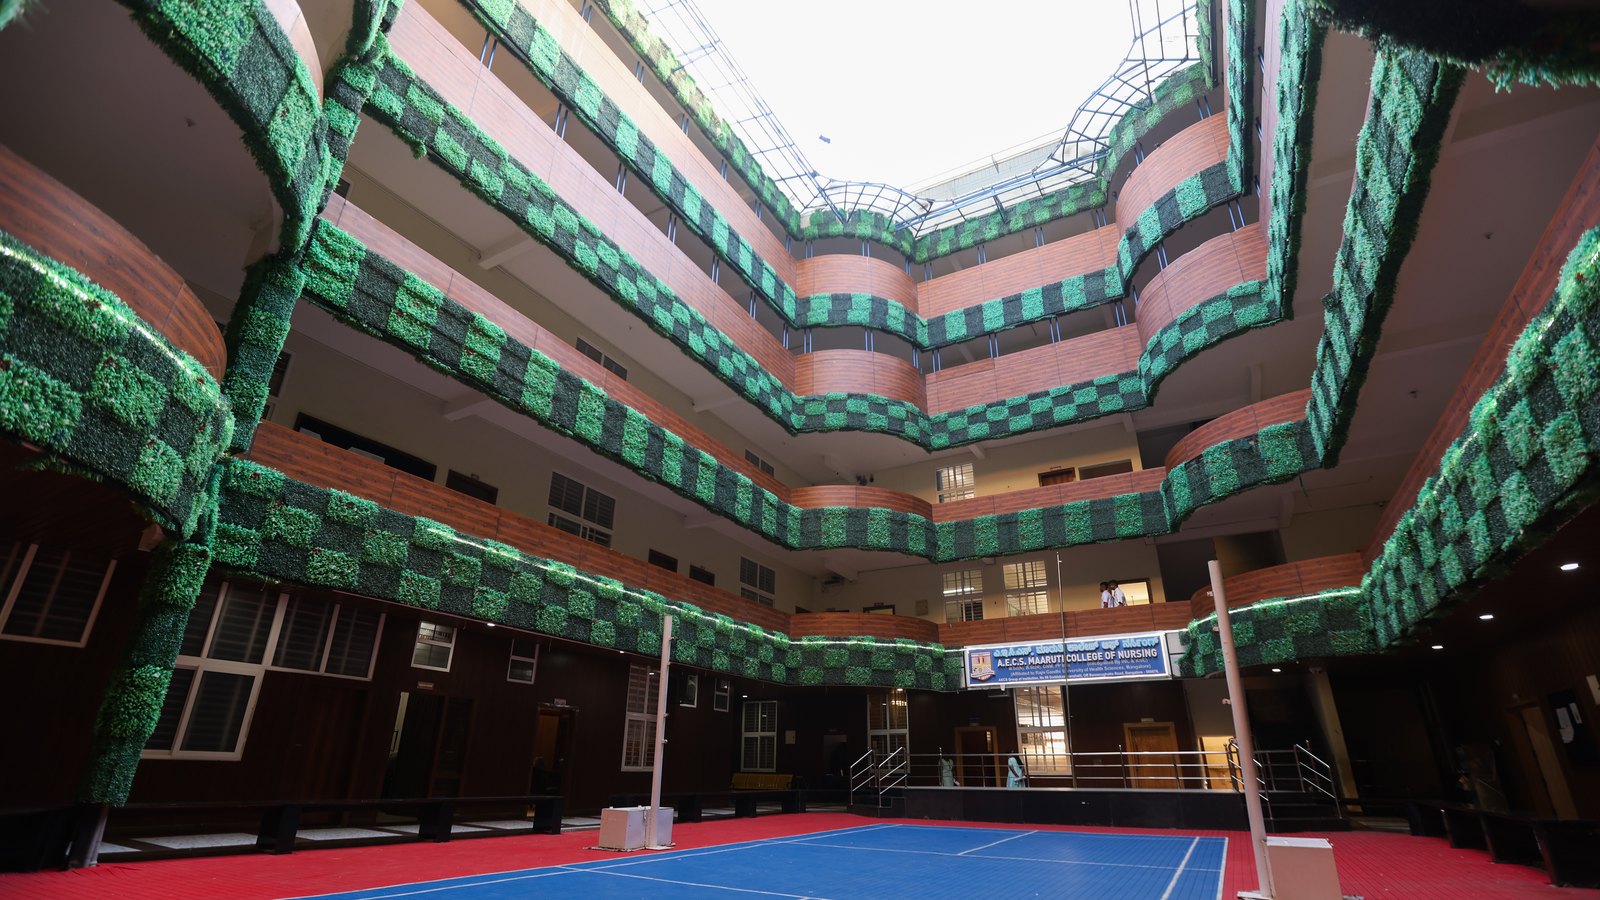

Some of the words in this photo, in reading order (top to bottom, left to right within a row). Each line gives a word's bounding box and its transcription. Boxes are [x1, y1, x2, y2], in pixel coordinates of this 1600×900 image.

[998, 658, 1027, 667] A.E.C.S.
[1028, 656, 1064, 665] MAARUTI
[1067, 652, 1104, 662] COLLEGE
[1105, 652, 1116, 660] OF
[1118, 649, 1157, 659] NURSING
